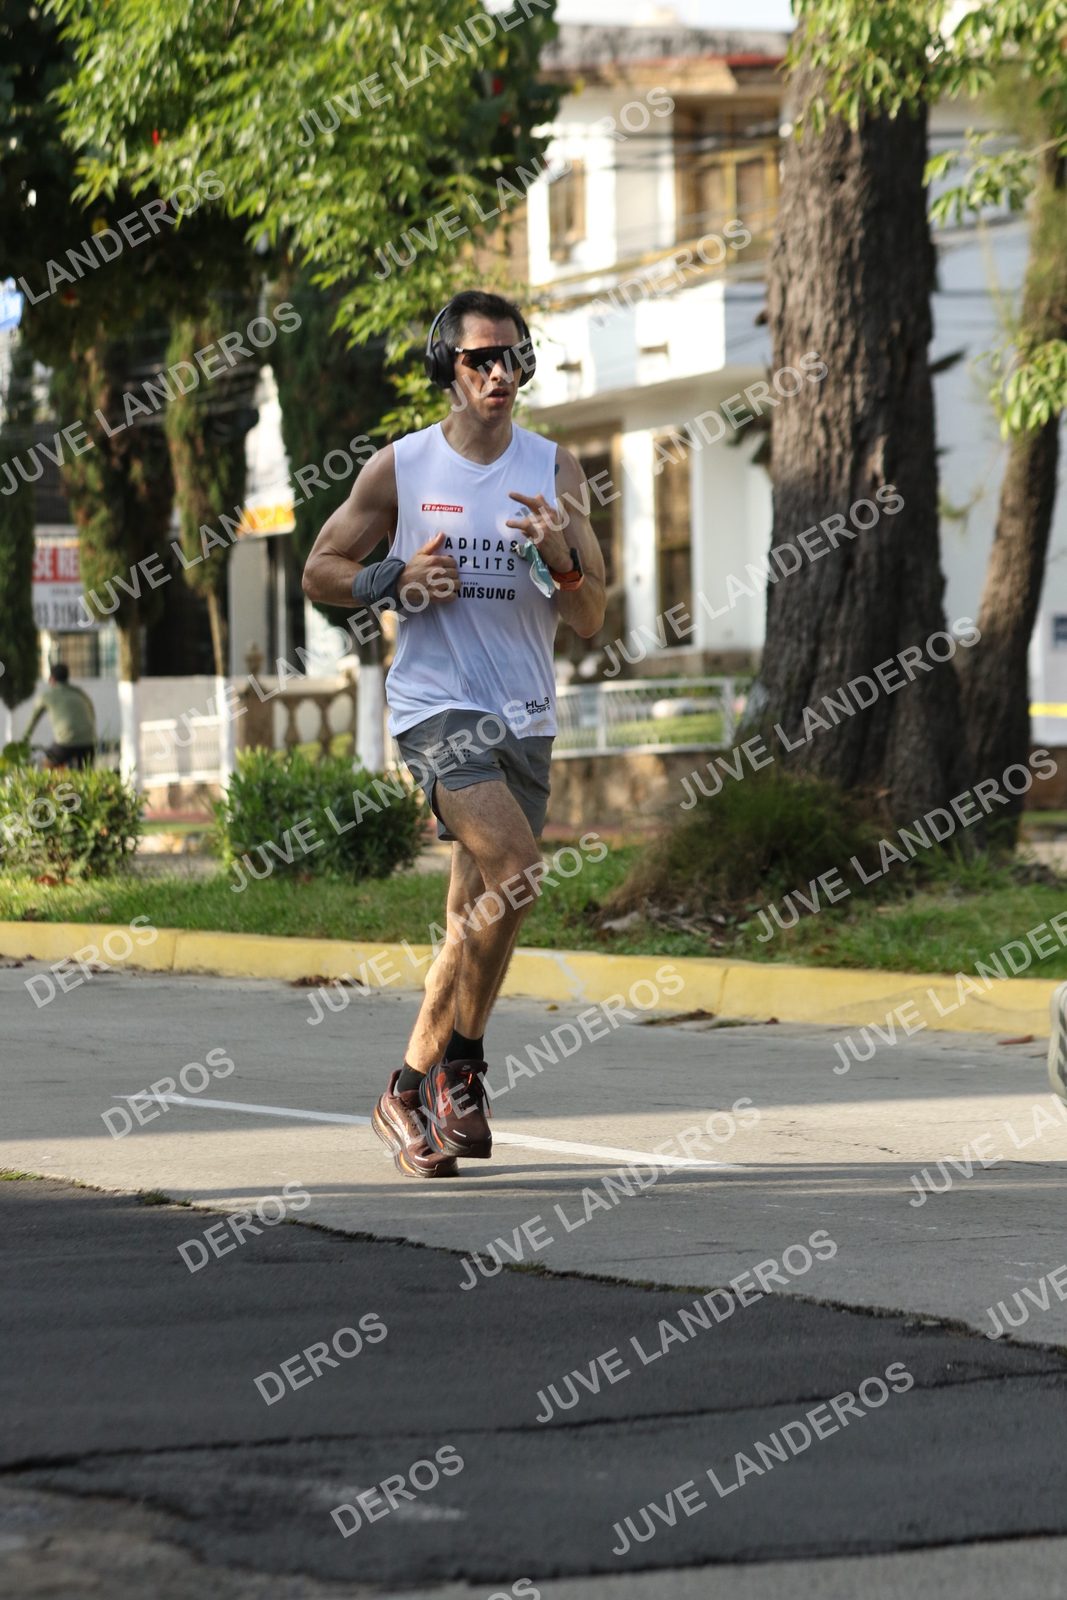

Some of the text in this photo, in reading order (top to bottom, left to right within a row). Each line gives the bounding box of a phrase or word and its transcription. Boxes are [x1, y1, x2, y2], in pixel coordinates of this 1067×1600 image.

[444, 537, 518, 553] ADIDAS
[450, 555, 515, 571] PLITS
[457, 586, 516, 601] MSUNG
